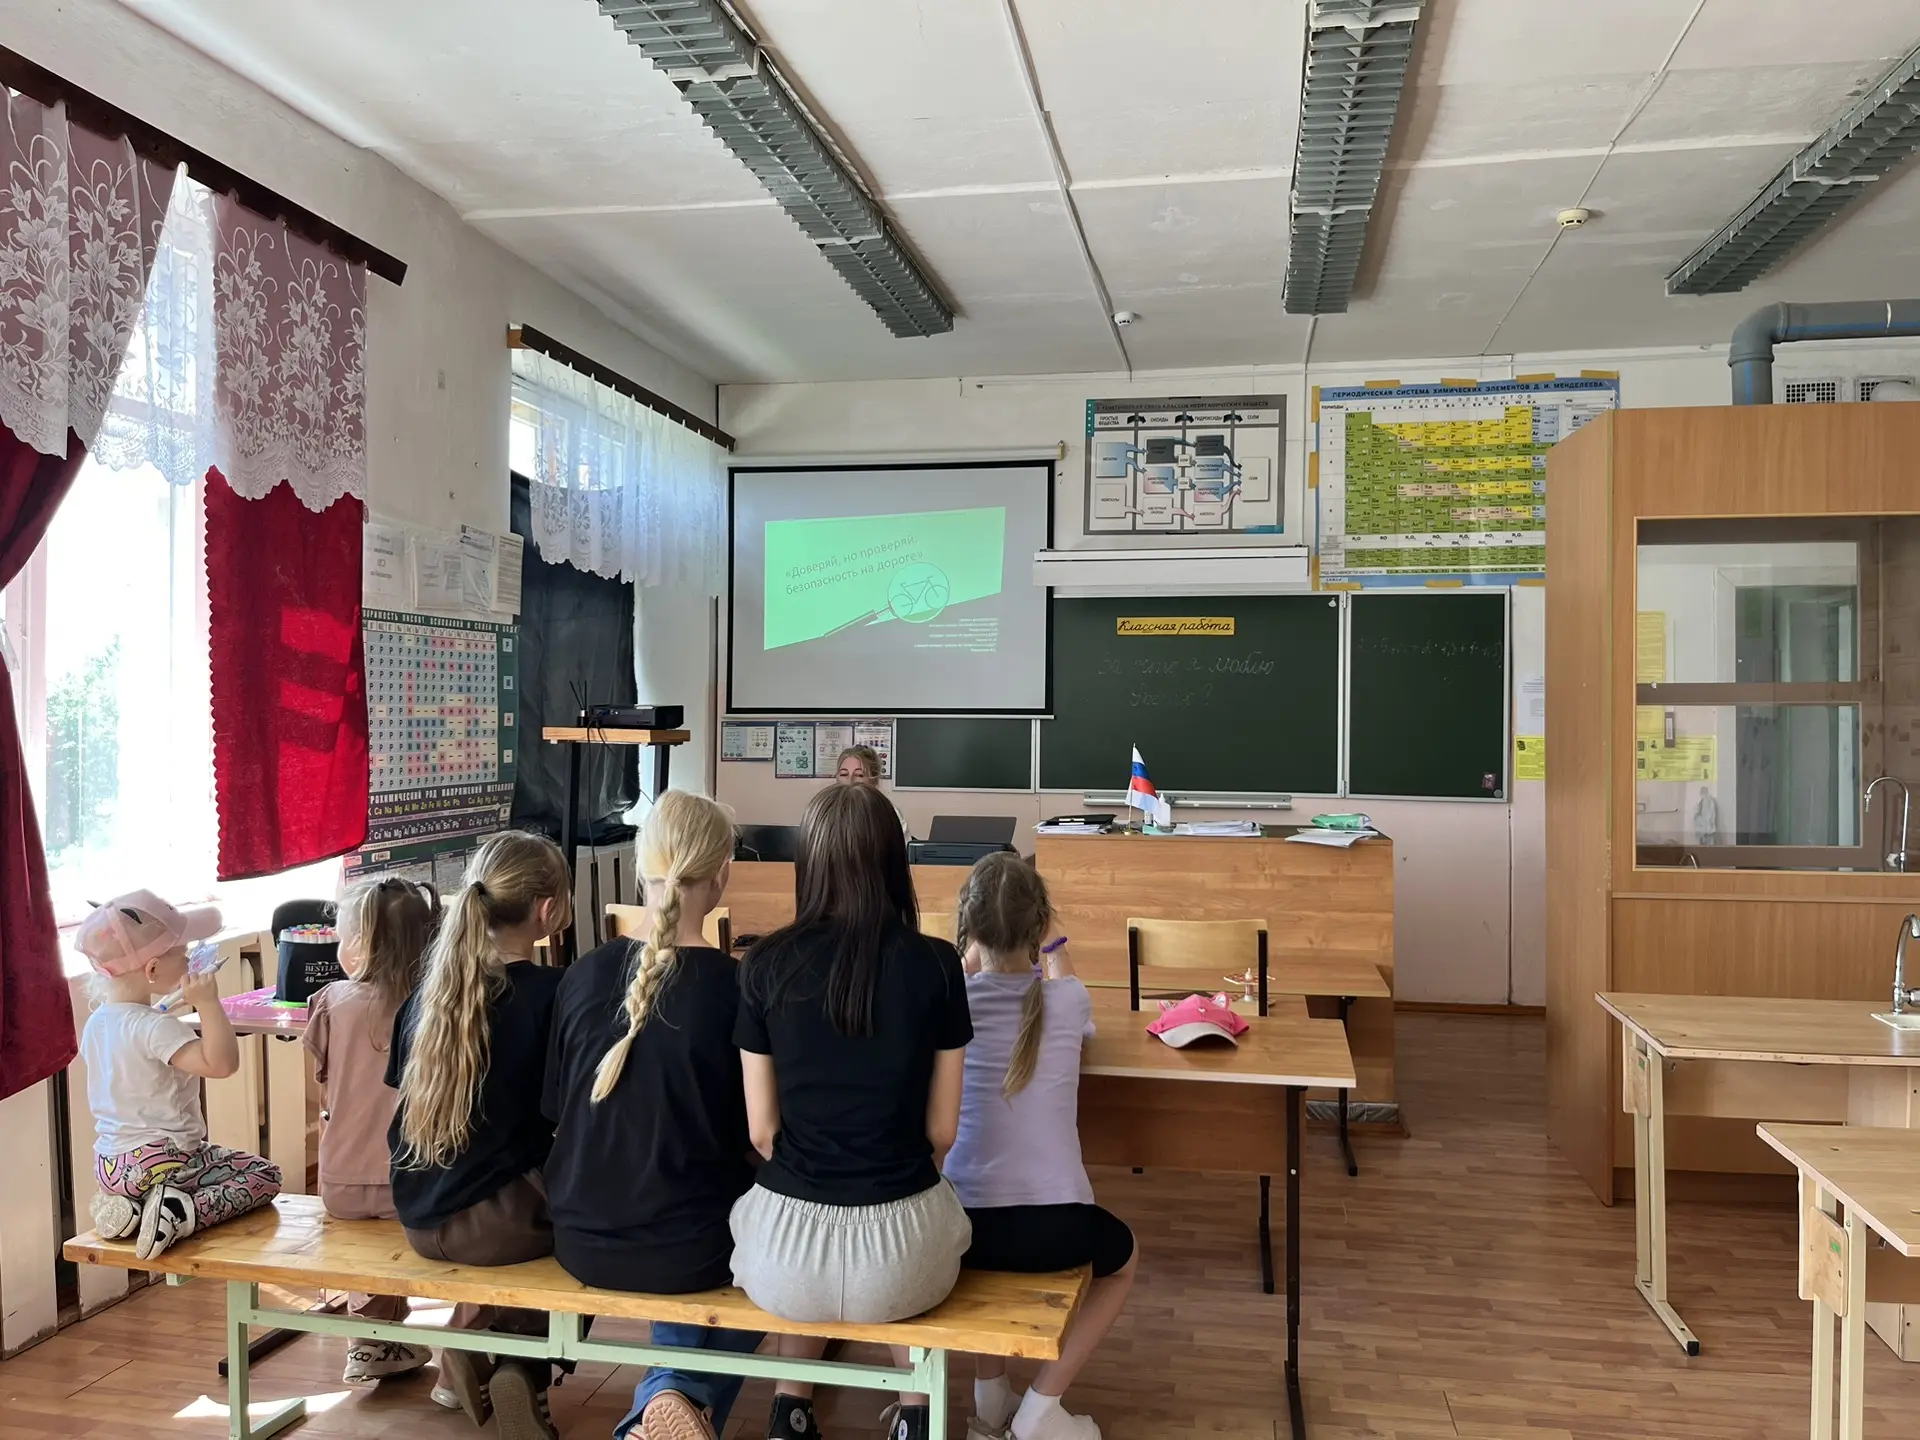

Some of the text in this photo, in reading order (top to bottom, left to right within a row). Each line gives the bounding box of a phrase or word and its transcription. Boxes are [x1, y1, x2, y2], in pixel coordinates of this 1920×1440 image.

[786, 556, 841, 578] «Доверяй,
[844, 552, 858, 563] но
[786, 551, 923, 595] безопасность на дороге»
[1118, 620, 1176, 631] Классная
[1097, 651, 1276, 675] За что я люблю
[368, 783, 514, 804] РОХИМИЧЕСКИЙ РЯД НАПРЯЖЕНИЙ МЕТАЛЛОВ
[374, 807, 382, 816] Ca
[384, 806, 392, 814] Na
[394, 805, 402, 815] Mg
[405, 803, 411, 811] Al
[411, 803, 419, 811] Mn
[420, 801, 427, 810] Zn
[428, 801, 435, 809] Fe
[443, 799, 451, 807] Sn
[452, 798, 460, 806] Pb
[468, 797, 475, 805] Cu
[476, 796, 484, 805] Ag
[484, 796, 491, 804] Hg
